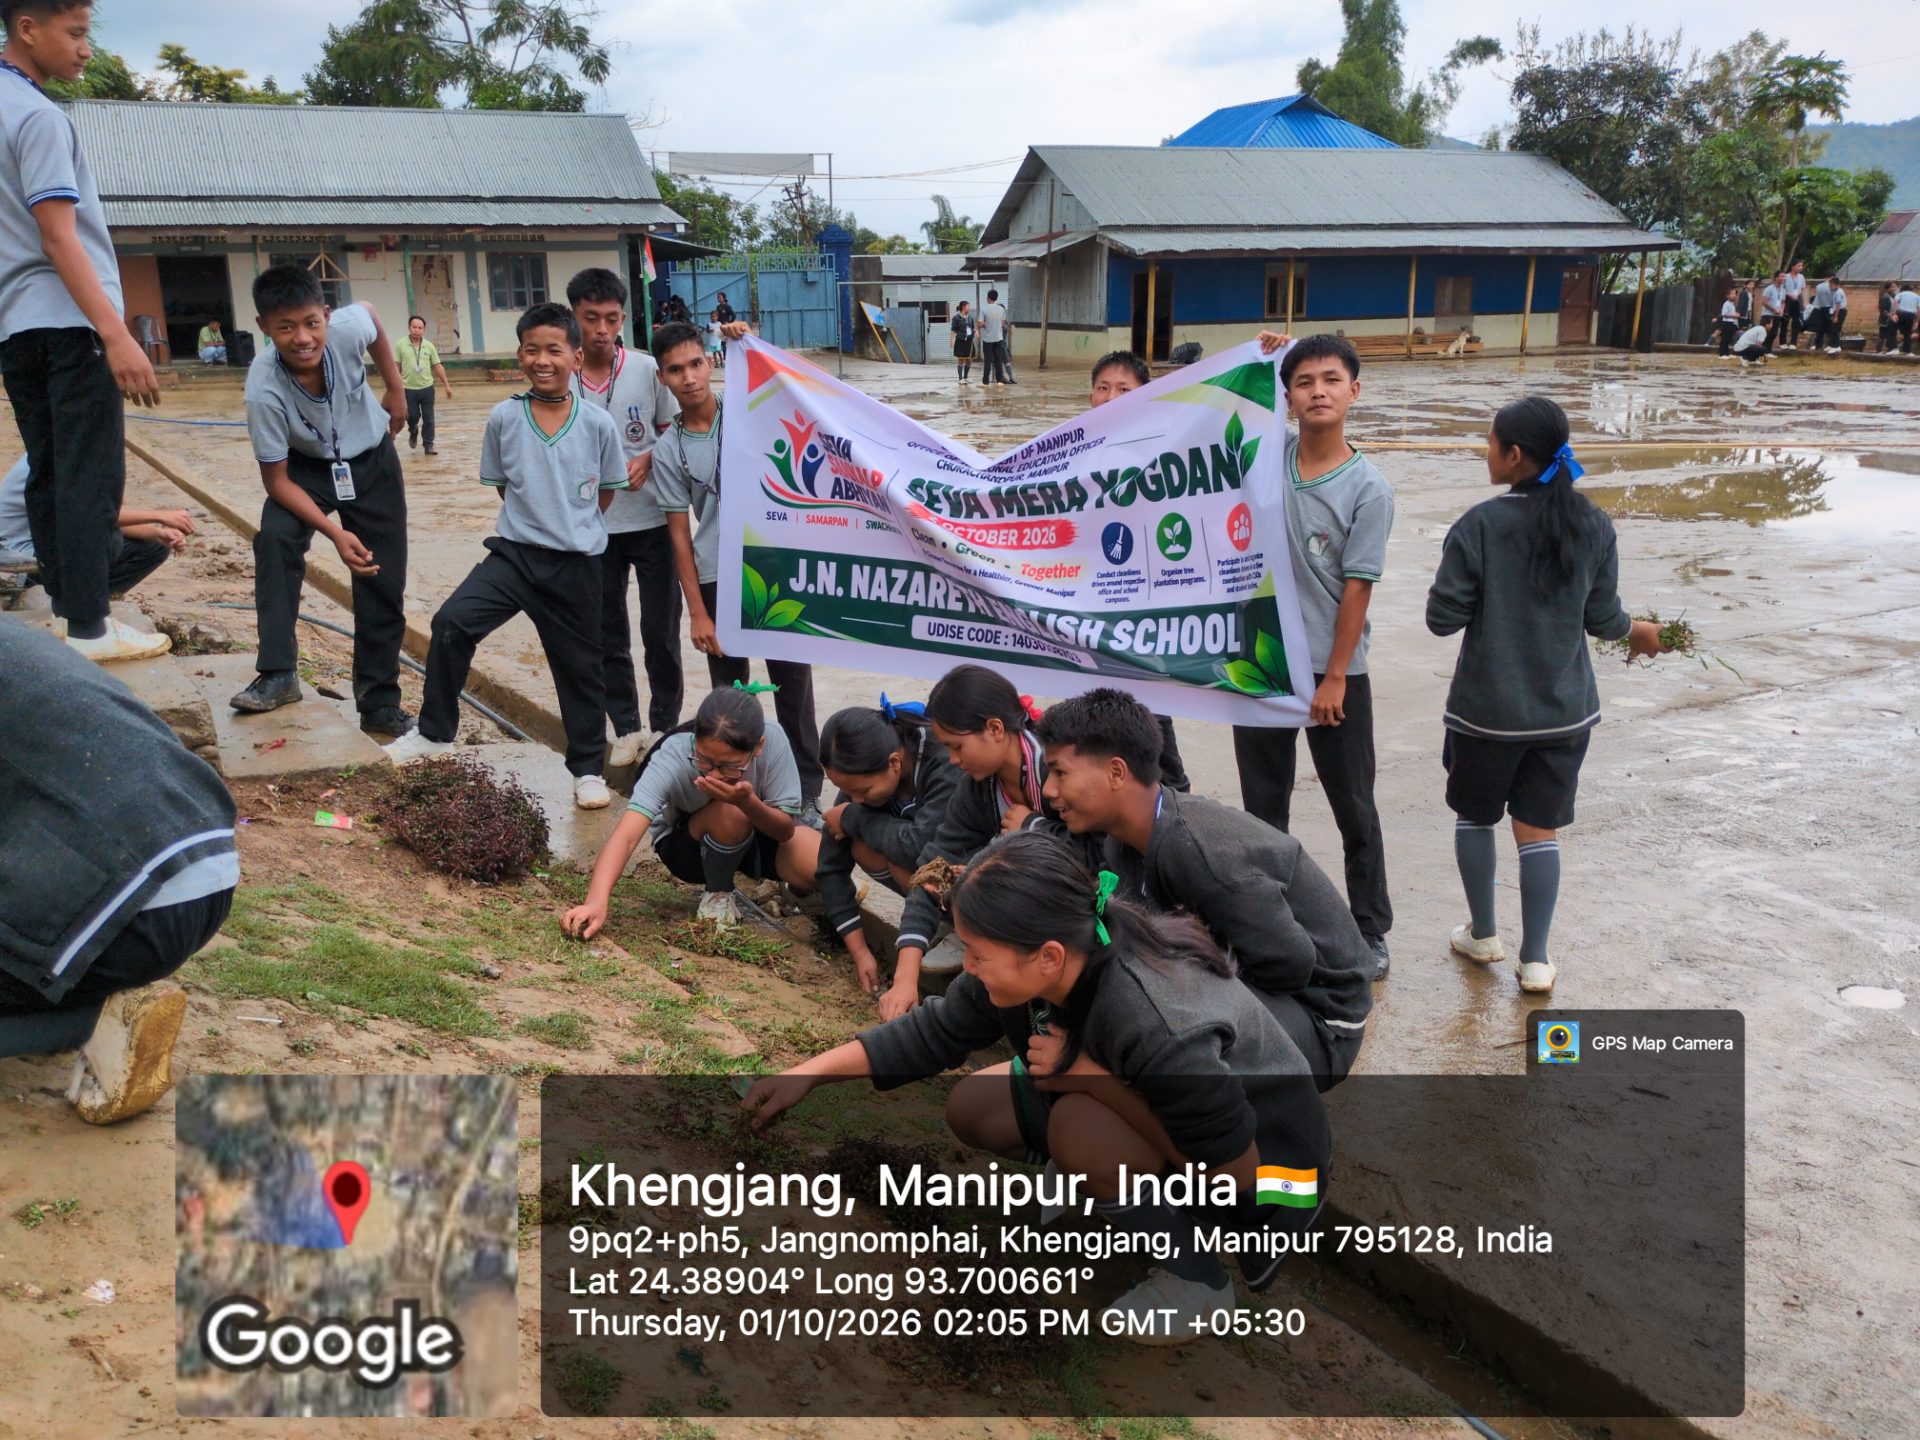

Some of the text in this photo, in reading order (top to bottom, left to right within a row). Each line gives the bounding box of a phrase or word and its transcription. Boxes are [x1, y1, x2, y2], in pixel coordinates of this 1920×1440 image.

[818, 431, 854, 463] SEVA
[1037, 427, 1085, 455] MANIPUR
[1017, 449, 1068, 474] EDUCATION
[1069, 436, 1106, 457] OFFICER
[904, 443, 1244, 520] SEVA MERA YOGDAN
[1026, 461, 1071, 480] MANIPUR
[766, 511, 788, 522] SEVA
[805, 513, 848, 528] SAMARPAN
[942, 523, 1018, 546] OCTOBER
[1022, 525, 1057, 546] 2026
[911, 527, 937, 548] Clean
[955, 541, 996, 565] Green
[1021, 563, 1081, 581] Together
[978, 568, 1013, 585] Healthier,
[1014, 579, 1045, 592] Greener
[1046, 587, 1077, 599] Manipur
[1096, 568, 1142, 579] Conduct cleanliness
[1106, 578, 1123, 587] around
[1123, 576, 1146, 587] respective
[1153, 577, 1180, 588] plantation
[1161, 566, 1195, 578] Organize tree
[1098, 586, 1139, 596] office and school
[788, 558, 844, 598] J.N.
[851, 563, 994, 618] NAZARETH
[984, 595, 1106, 650] ENGLISH
[1108, 612, 1241, 656] SCHOOL
[927, 621, 965, 640] UDISE
[967, 626, 1002, 646] CODE
